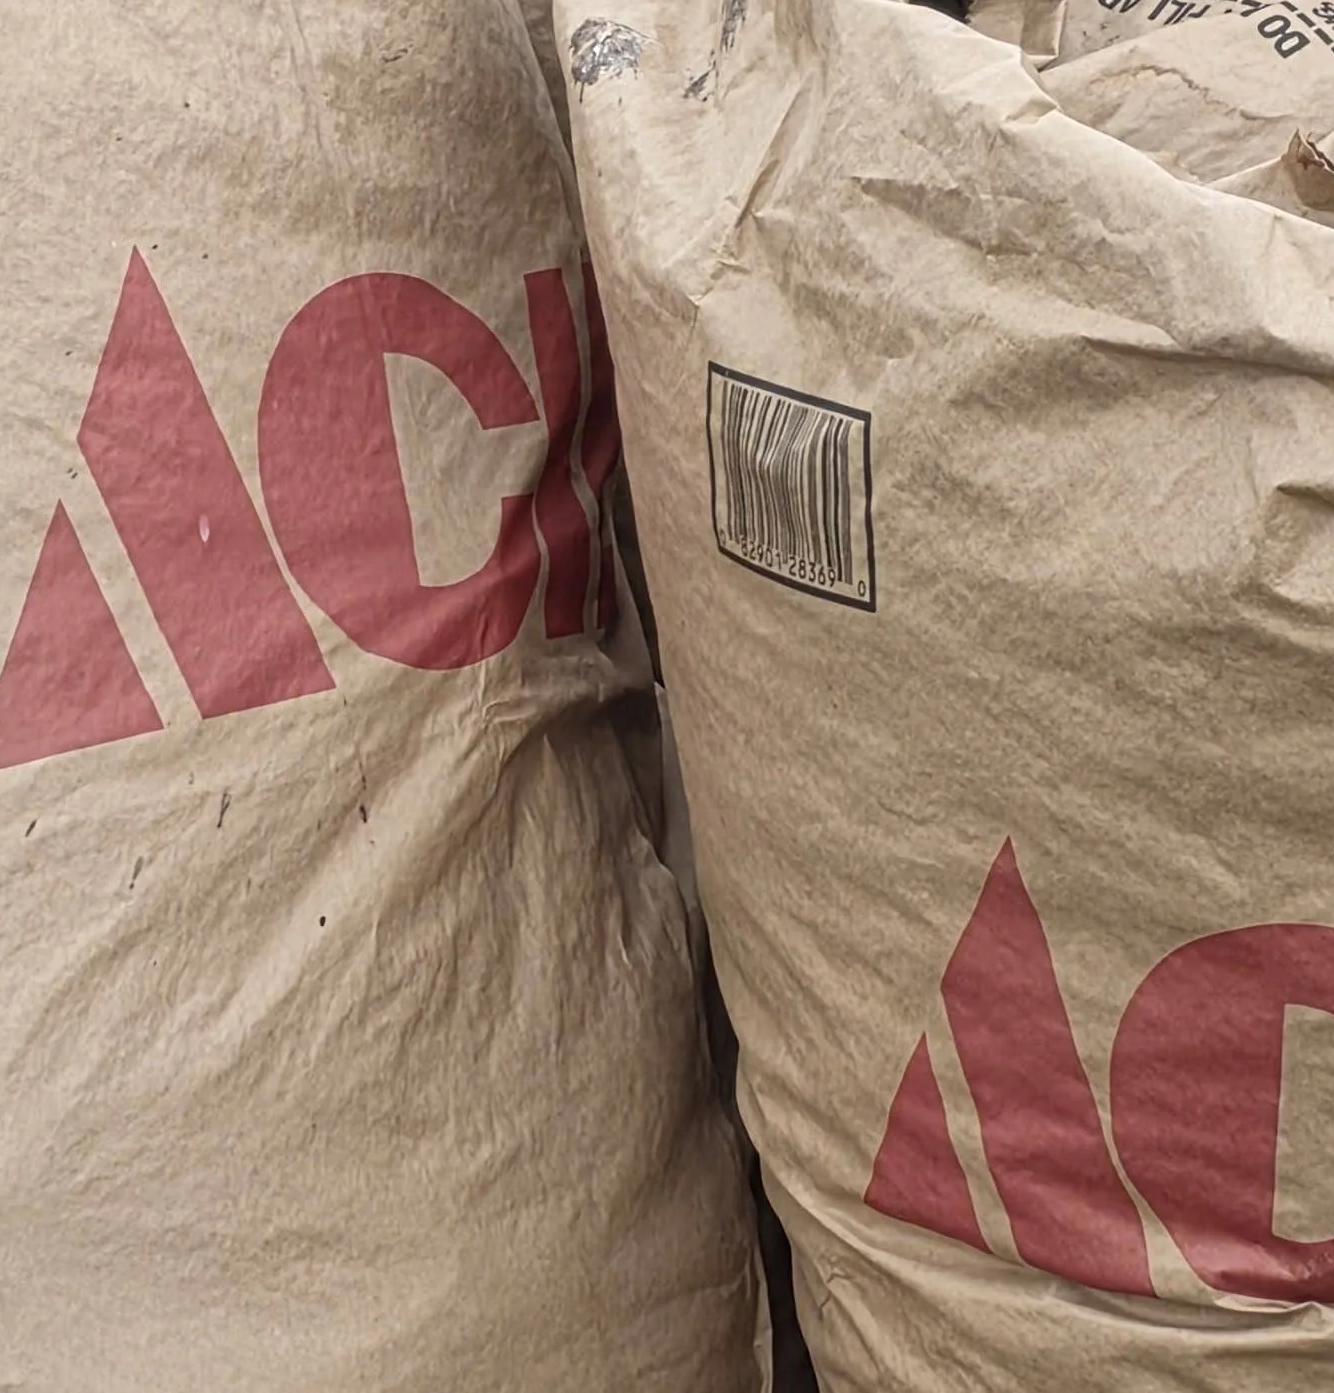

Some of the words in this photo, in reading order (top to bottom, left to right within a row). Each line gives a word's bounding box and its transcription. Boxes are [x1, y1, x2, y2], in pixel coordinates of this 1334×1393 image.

[1257, 14, 1312, 60] DO
[788, 556, 837, 588] 28369
[857, 580, 867, 598] 0
